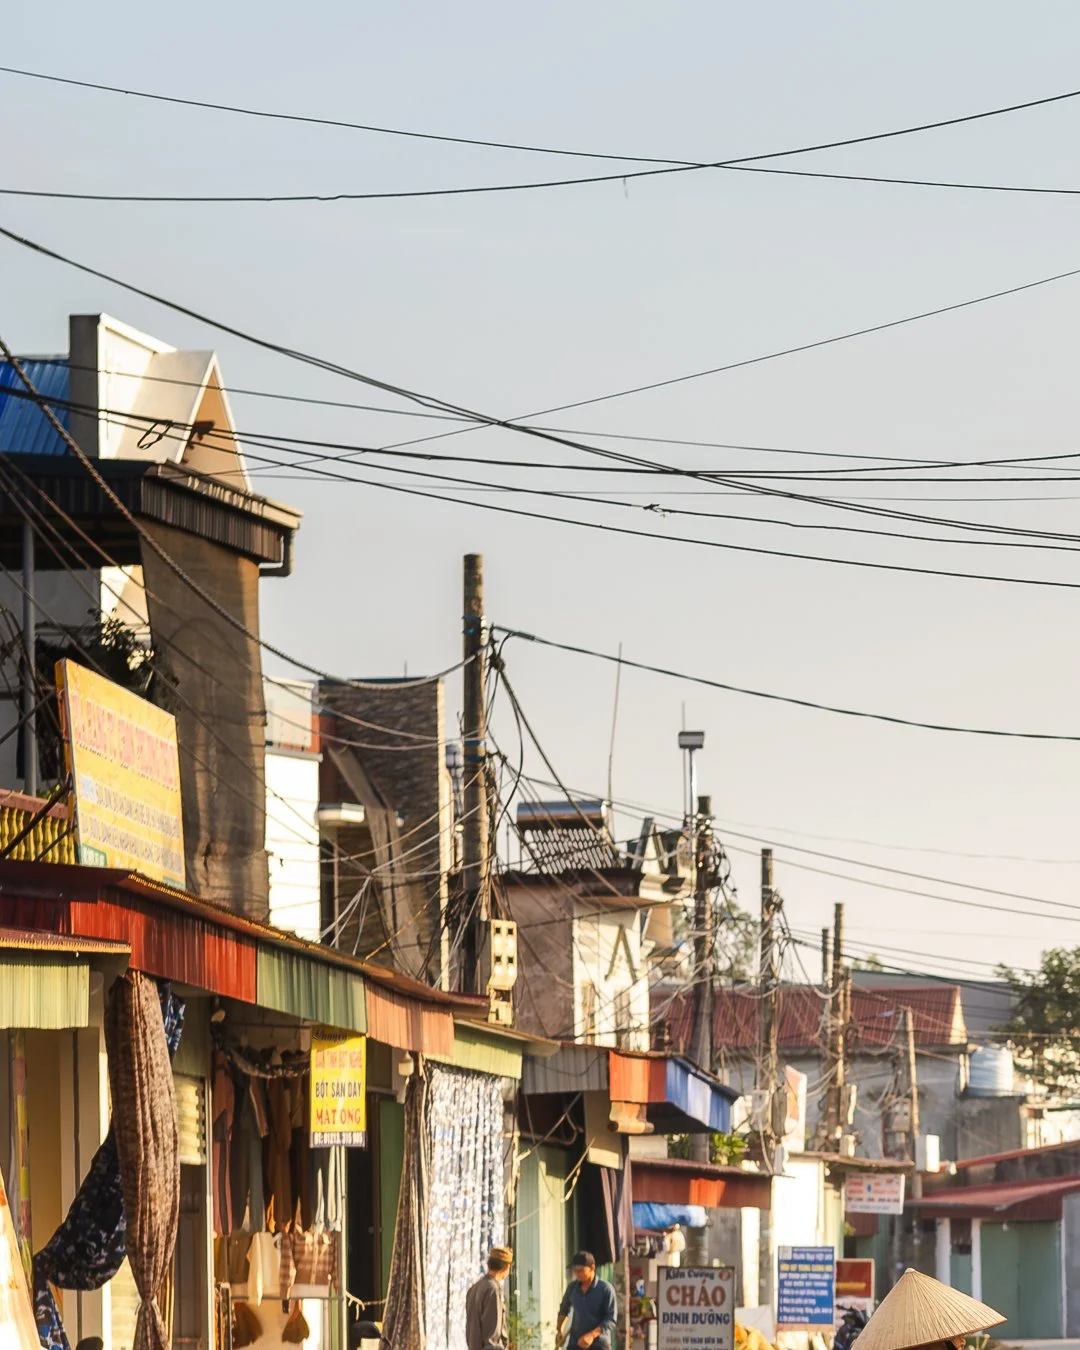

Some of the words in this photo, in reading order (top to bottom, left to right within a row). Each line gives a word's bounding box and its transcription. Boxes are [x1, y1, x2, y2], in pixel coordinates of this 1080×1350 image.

[340, 1107, 361, 1125] ONG
[666, 1278, 726, 1307] CHÁO
[662, 1311, 689, 1325] DINH
[691, 1308, 730, 1325] DƯỠNG
